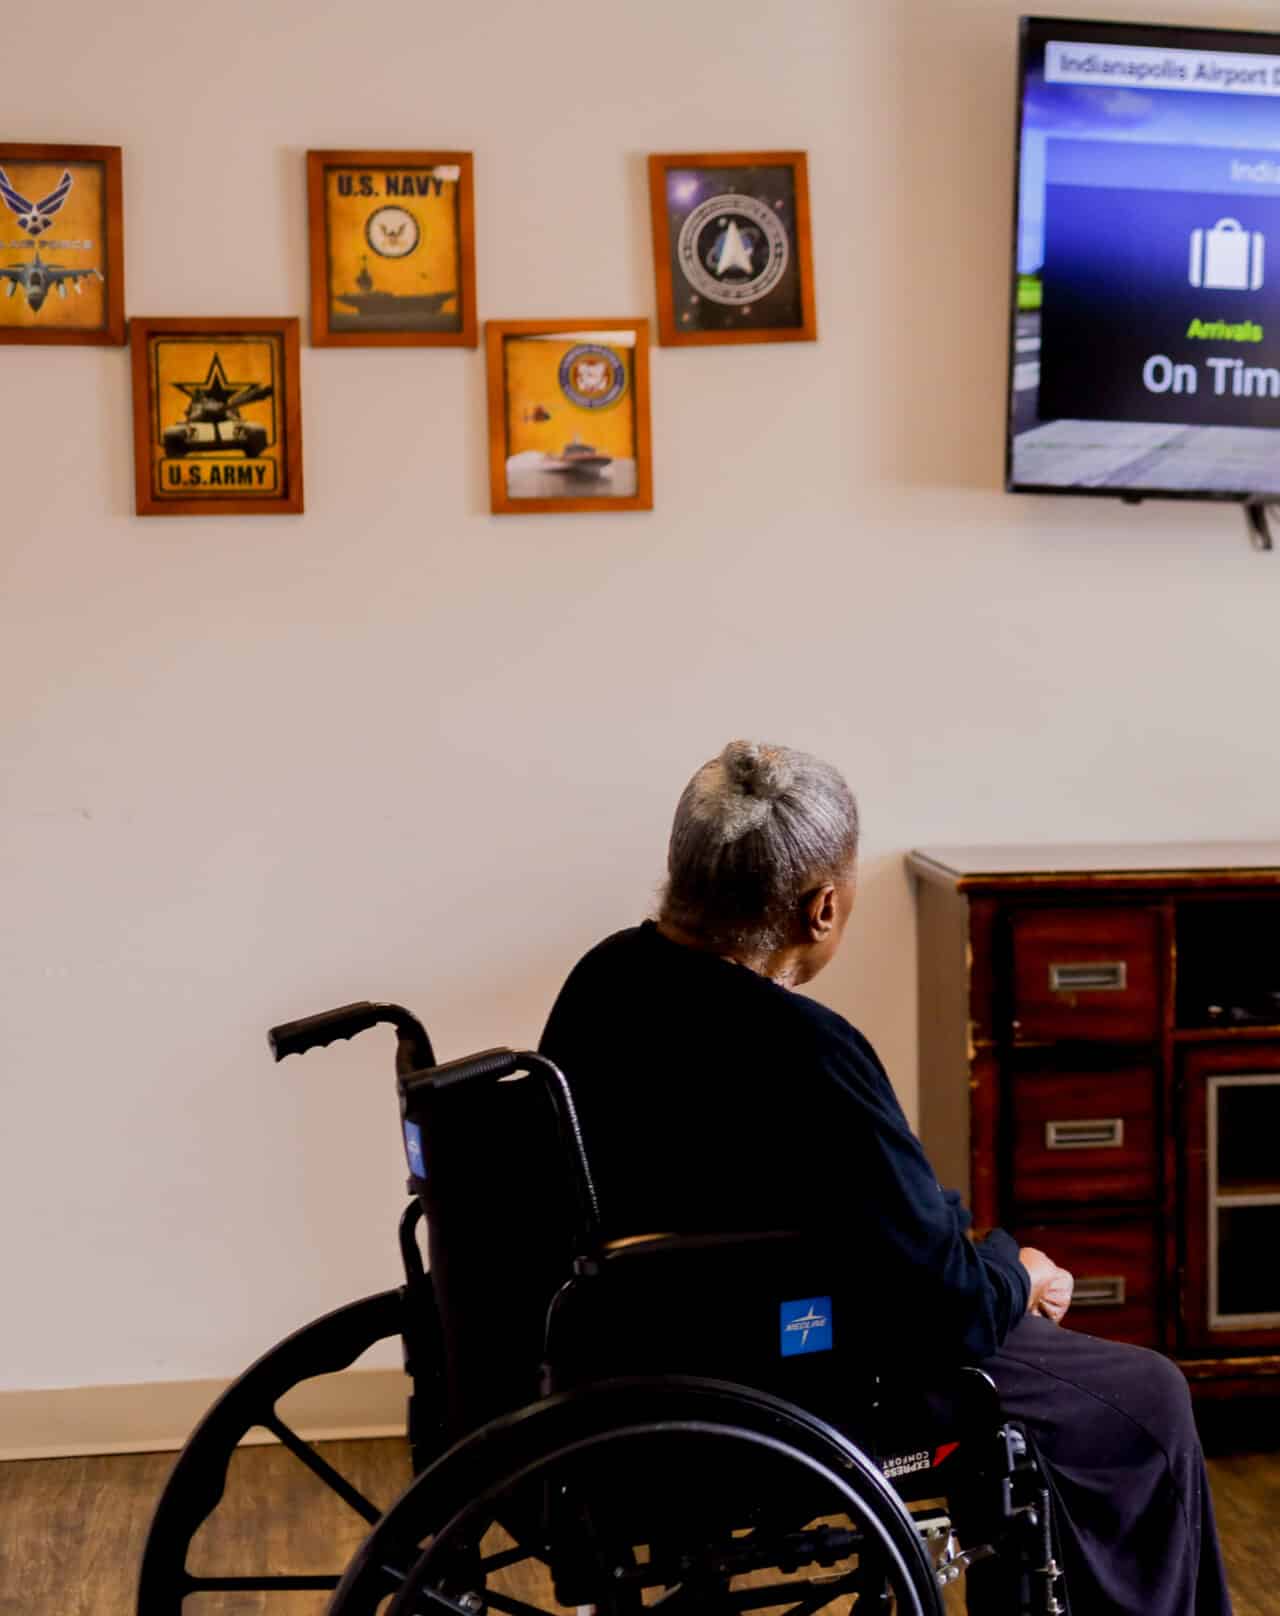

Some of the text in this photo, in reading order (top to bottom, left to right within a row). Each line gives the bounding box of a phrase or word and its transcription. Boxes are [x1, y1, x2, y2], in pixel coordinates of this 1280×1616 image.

[1059, 54, 1187, 81] Indianapolis
[1194, 61, 1268, 87] Airport
[385, 175, 446, 197] NAVY
[1186, 318, 1264, 343] Arrivals
[1142, 354, 1198, 395] On
[882, 1450, 930, 1469] COMFORT
[882, 1459, 931, 1479] EXPRESS
